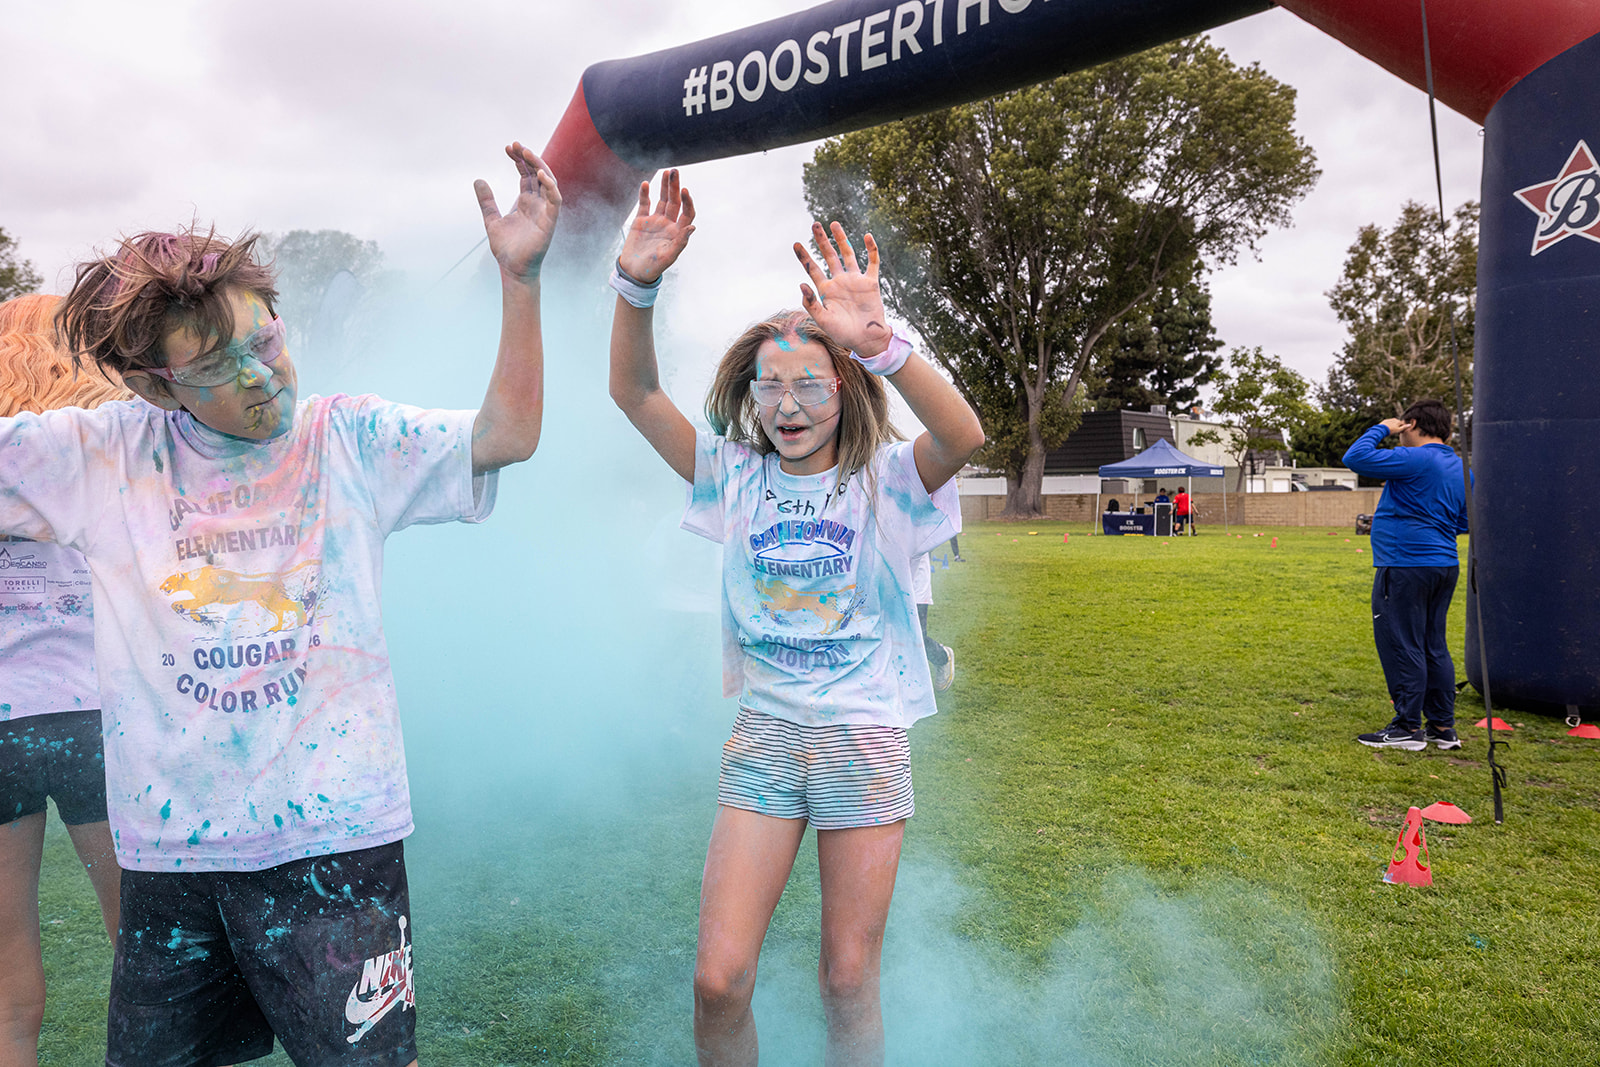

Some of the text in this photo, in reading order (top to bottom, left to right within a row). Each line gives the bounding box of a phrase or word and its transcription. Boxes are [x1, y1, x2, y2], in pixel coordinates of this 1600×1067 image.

[682, 0, 1050, 116] #BOOSTERTH
[175, 524, 300, 561] ELEMENTAR
[753, 555, 853, 578] ELEMENTARY
[0, 602, 42, 614] ogurtland
[162, 653, 175, 667] 20
[193, 638, 296, 670] COUGAR
[767, 641, 810, 669] OLOR
[176, 673, 258, 713] COLOR
